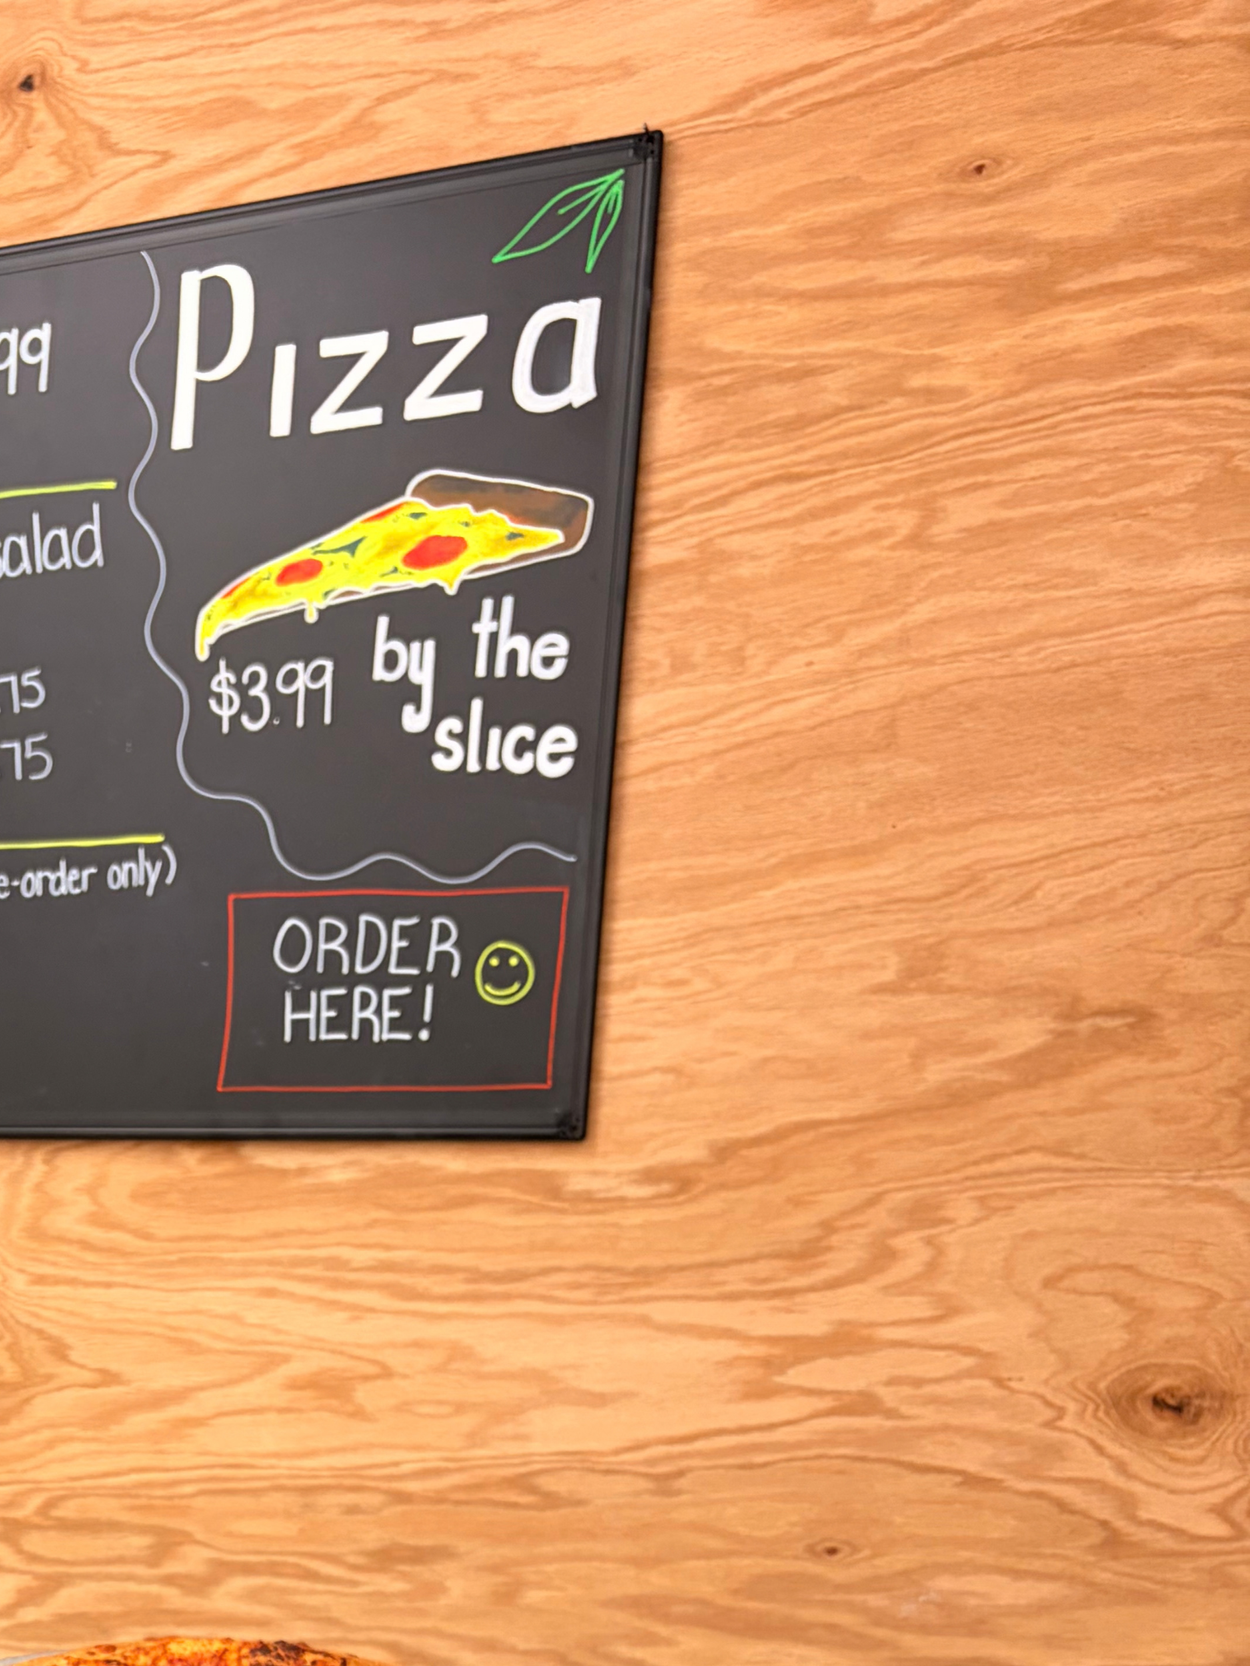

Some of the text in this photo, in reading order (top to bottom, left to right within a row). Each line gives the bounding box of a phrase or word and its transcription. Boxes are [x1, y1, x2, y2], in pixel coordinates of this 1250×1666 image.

[170, 263, 601, 451] Pizza
[208, 658, 335, 734] $3.99
[372, 595, 570, 733] by the
[432, 697, 578, 778] slice
[107, 844, 177, 897] only)
[272, 914, 461, 978] ORDER
[283, 982, 435, 1043] HERE!
